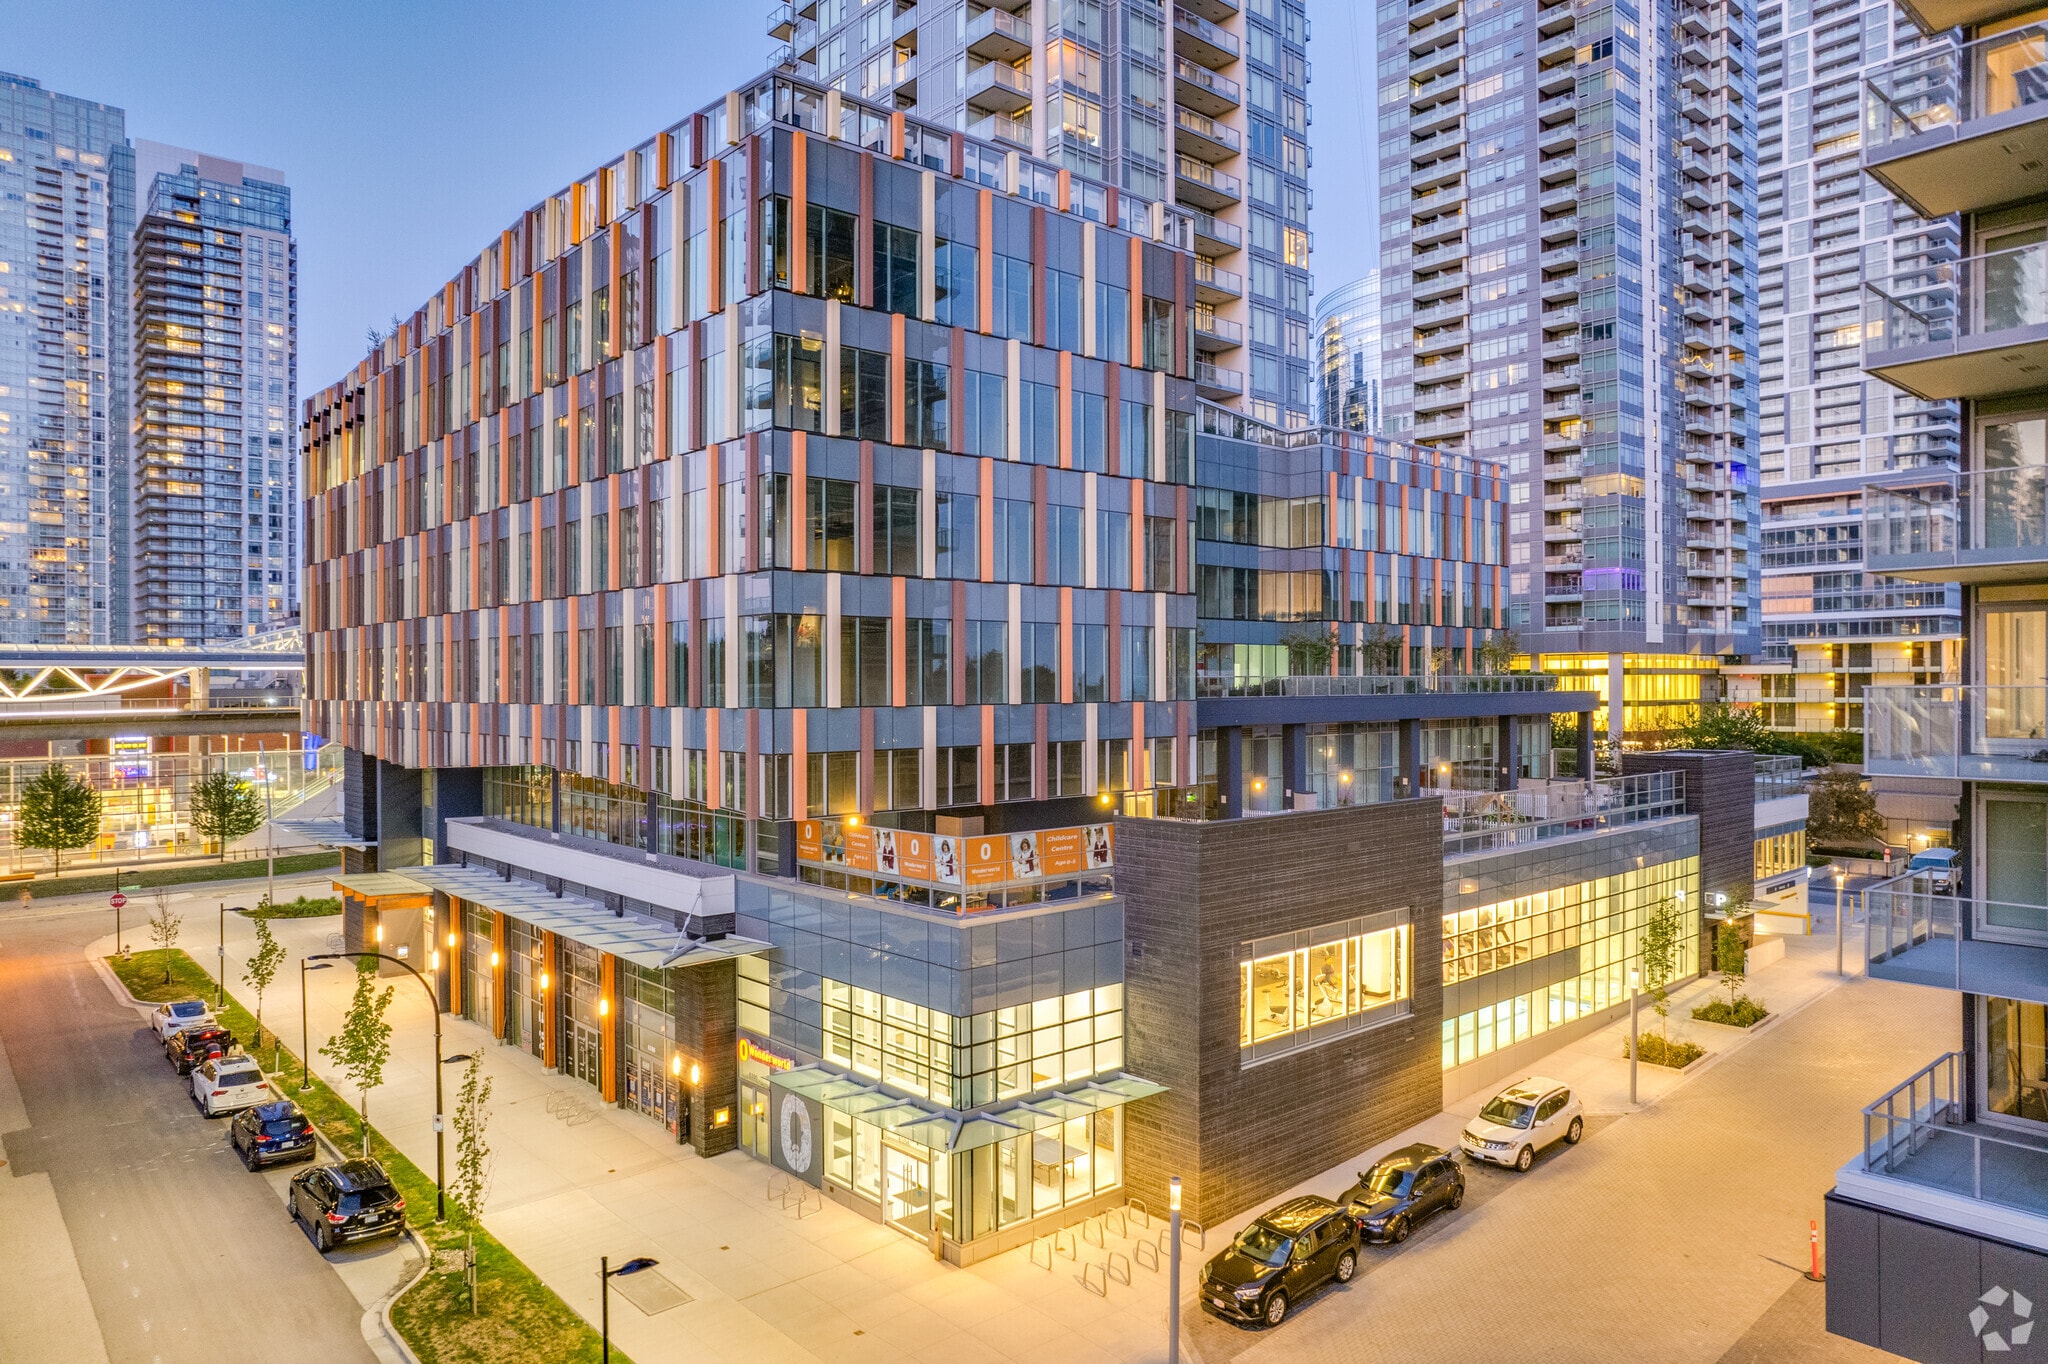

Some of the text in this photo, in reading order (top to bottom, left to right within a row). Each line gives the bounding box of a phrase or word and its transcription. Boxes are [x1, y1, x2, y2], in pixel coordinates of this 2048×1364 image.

[1047, 834, 1078, 842] Childcare
[110, 897, 127, 905] STOP
[1716, 893, 1727, 907] P
[749, 1044, 793, 1071] Wonderworld
